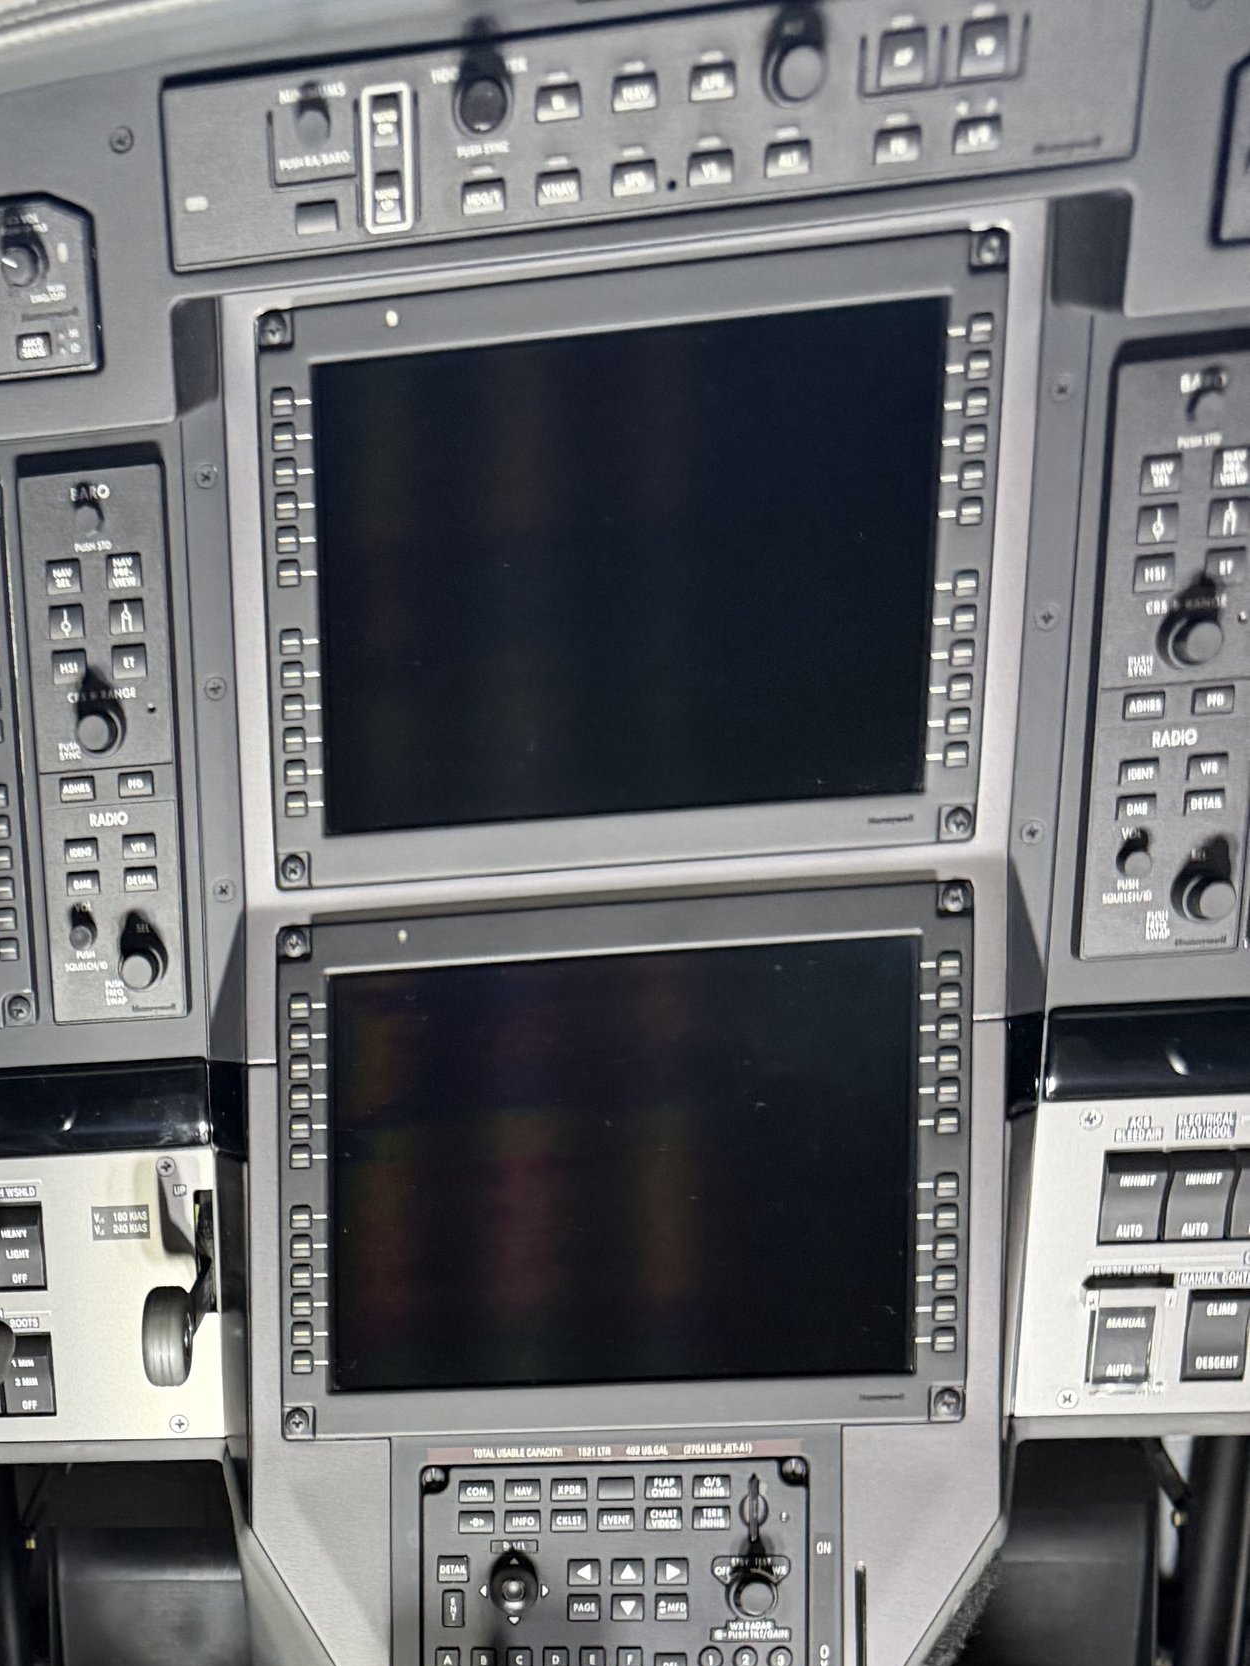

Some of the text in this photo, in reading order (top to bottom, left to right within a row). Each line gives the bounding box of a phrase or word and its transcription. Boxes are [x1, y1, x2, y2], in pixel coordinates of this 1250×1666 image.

[622, 85, 651, 100] NAV
[541, 181, 579, 198] VNAV
[112, 558, 133, 568] NAV
[53, 568, 73, 579] NAV
[59, 663, 78, 675] HSI
[1152, 728, 1198, 748] RADIO
[89, 811, 129, 828] RADIO
[1119, 1174, 1157, 1187] INHIBIT
[173, 1185, 186, 1196] UP
[113, 1211, 148, 1222] 180 KIAS
[129, 1223, 148, 1233] KIAS
[1116, 1224, 1143, 1238] AUTO
[1181, 1223, 1209, 1237] AUTO
[0, 1229, 27, 1239] HEAVY
[5, 1249, 30, 1260] LIGHT
[1180, 1272, 1218, 1285] MANUAL
[1206, 1302, 1238, 1317] CLIMB
[10, 1318, 39, 1329] BOOTS
[1106, 1317, 1147, 1329] MANUAL
[1106, 1364, 1133, 1377] AUTO
[473, 1448, 495, 1459] TOTAL
[496, 1448, 526, 1459] USABLE
[466, 1487, 488, 1497] COM
[513, 1486, 532, 1496] NAV
[557, 1485, 581, 1496] XPDR
[512, 1516, 535, 1527] INFO
[556, 1515, 582, 1526] CKLST
[602, 1514, 631, 1526] EVENT
[816, 1542, 832, 1554] ON
[439, 1564, 466, 1575] DETAIL
[573, 1602, 596, 1613] PAGE
[667, 1602, 687, 1613] MFD
[443, 1655, 453, 1666] A
[480, 1655, 488, 1666] B
[515, 1655, 523, 1666] C
[551, 1655, 560, 1666] D
[708, 1655, 714, 1666] 1
[741, 1655, 750, 1666] 2
